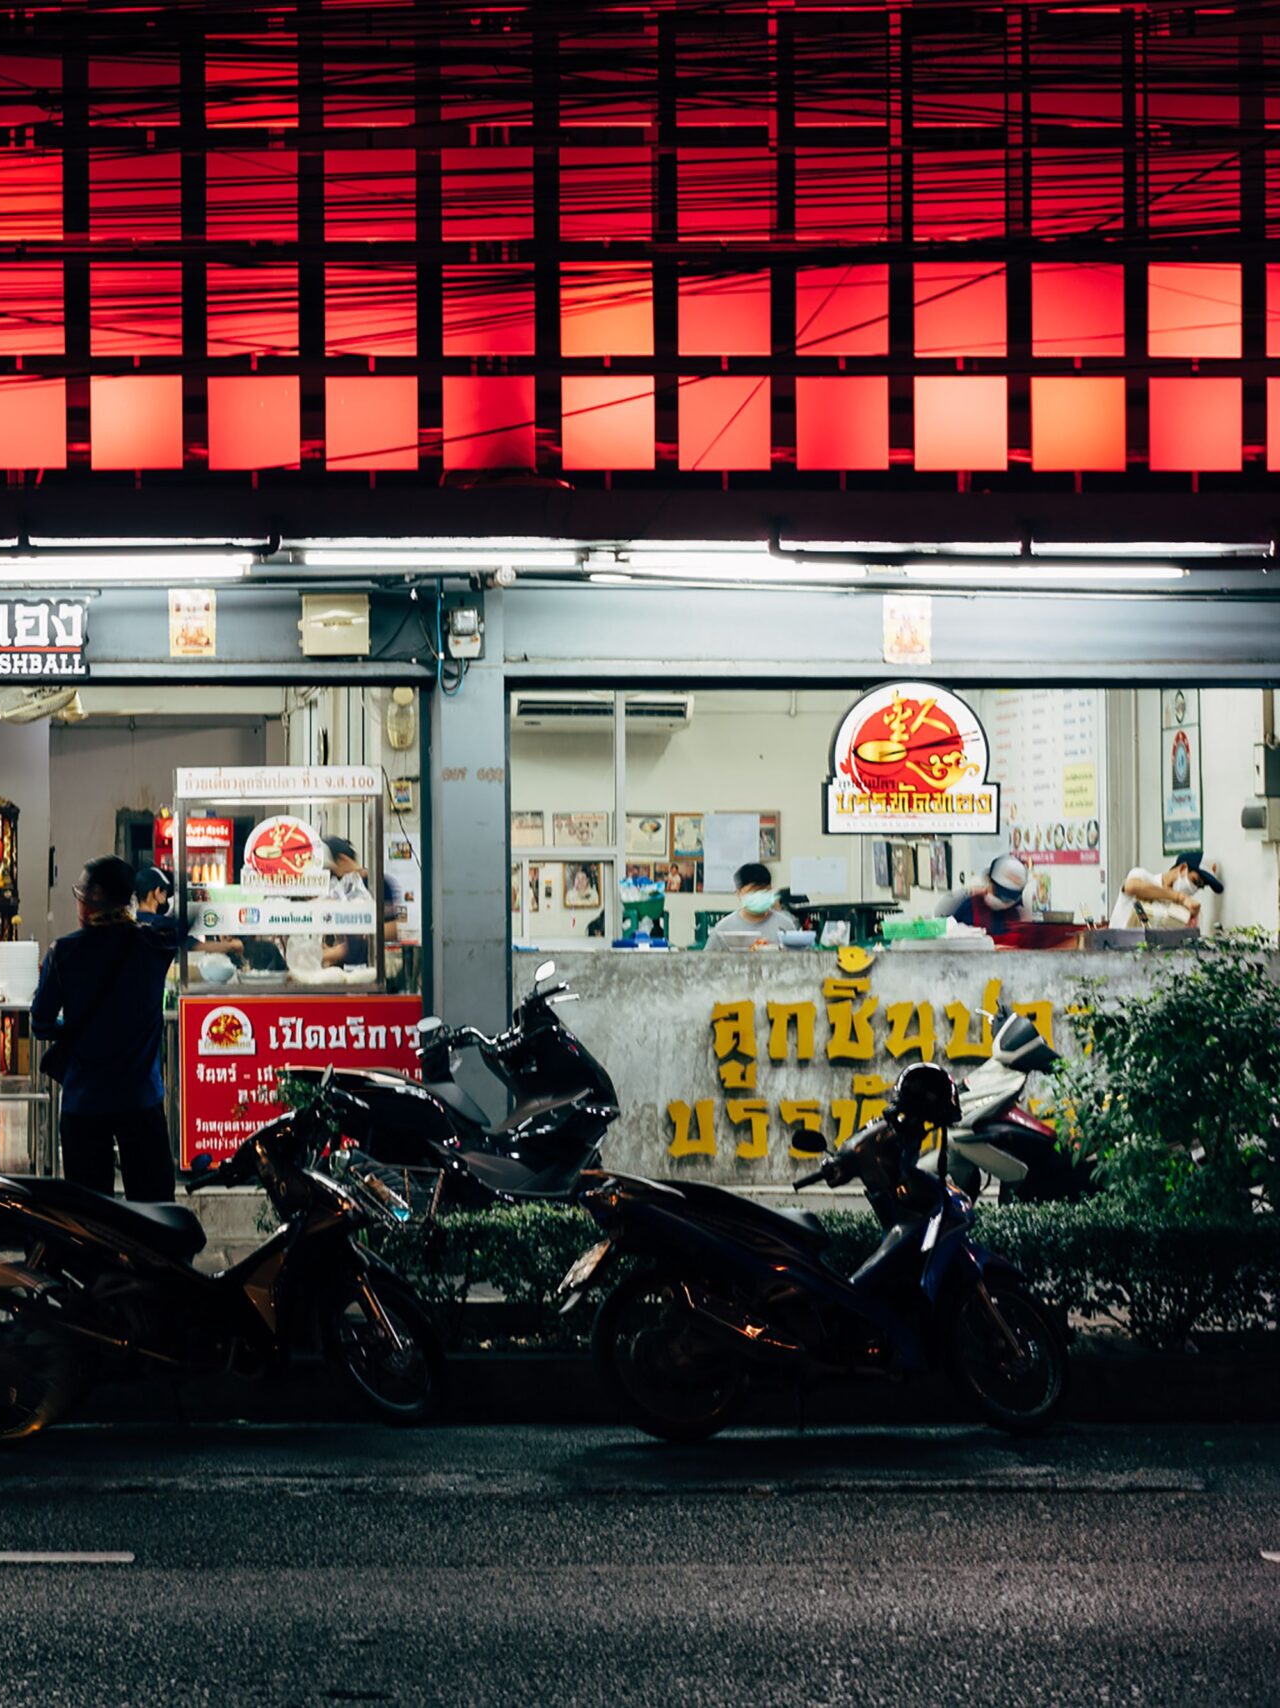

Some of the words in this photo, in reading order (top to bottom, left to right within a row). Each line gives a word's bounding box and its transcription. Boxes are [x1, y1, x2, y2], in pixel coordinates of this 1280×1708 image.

[351, 774, 375, 789] 100
[269, 1016, 421, 1050] เปิดบริการ
